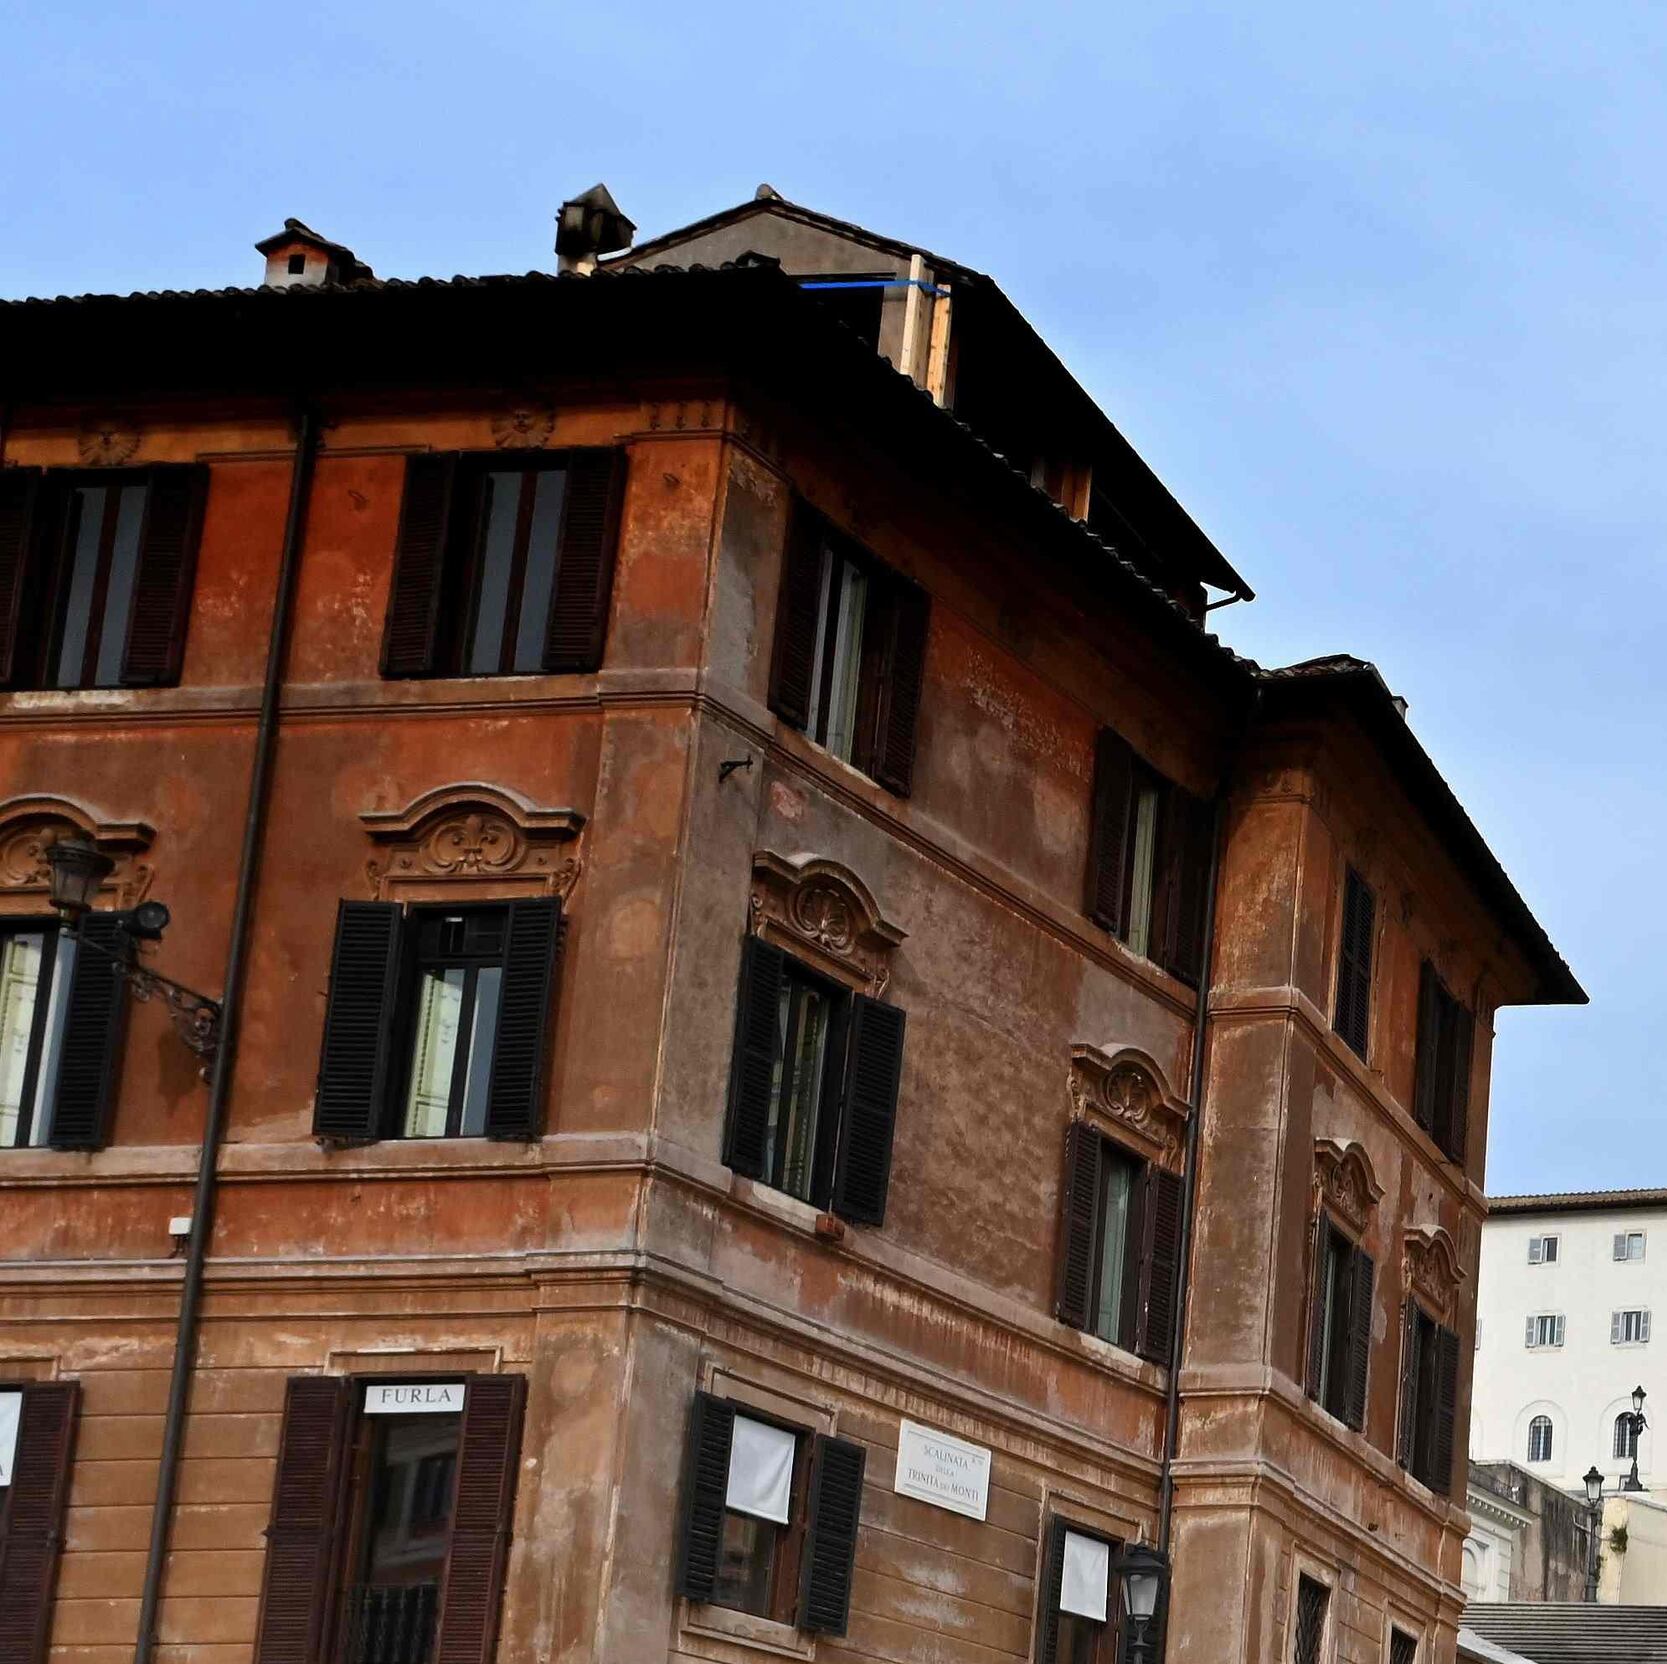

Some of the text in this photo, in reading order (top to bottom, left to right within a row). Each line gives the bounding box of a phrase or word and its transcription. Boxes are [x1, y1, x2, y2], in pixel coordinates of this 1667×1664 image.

[381, 1387, 452, 1404] FURLA
[923, 1444, 969, 1470] SCALINATA
[951, 1483, 980, 1502] MONTI
